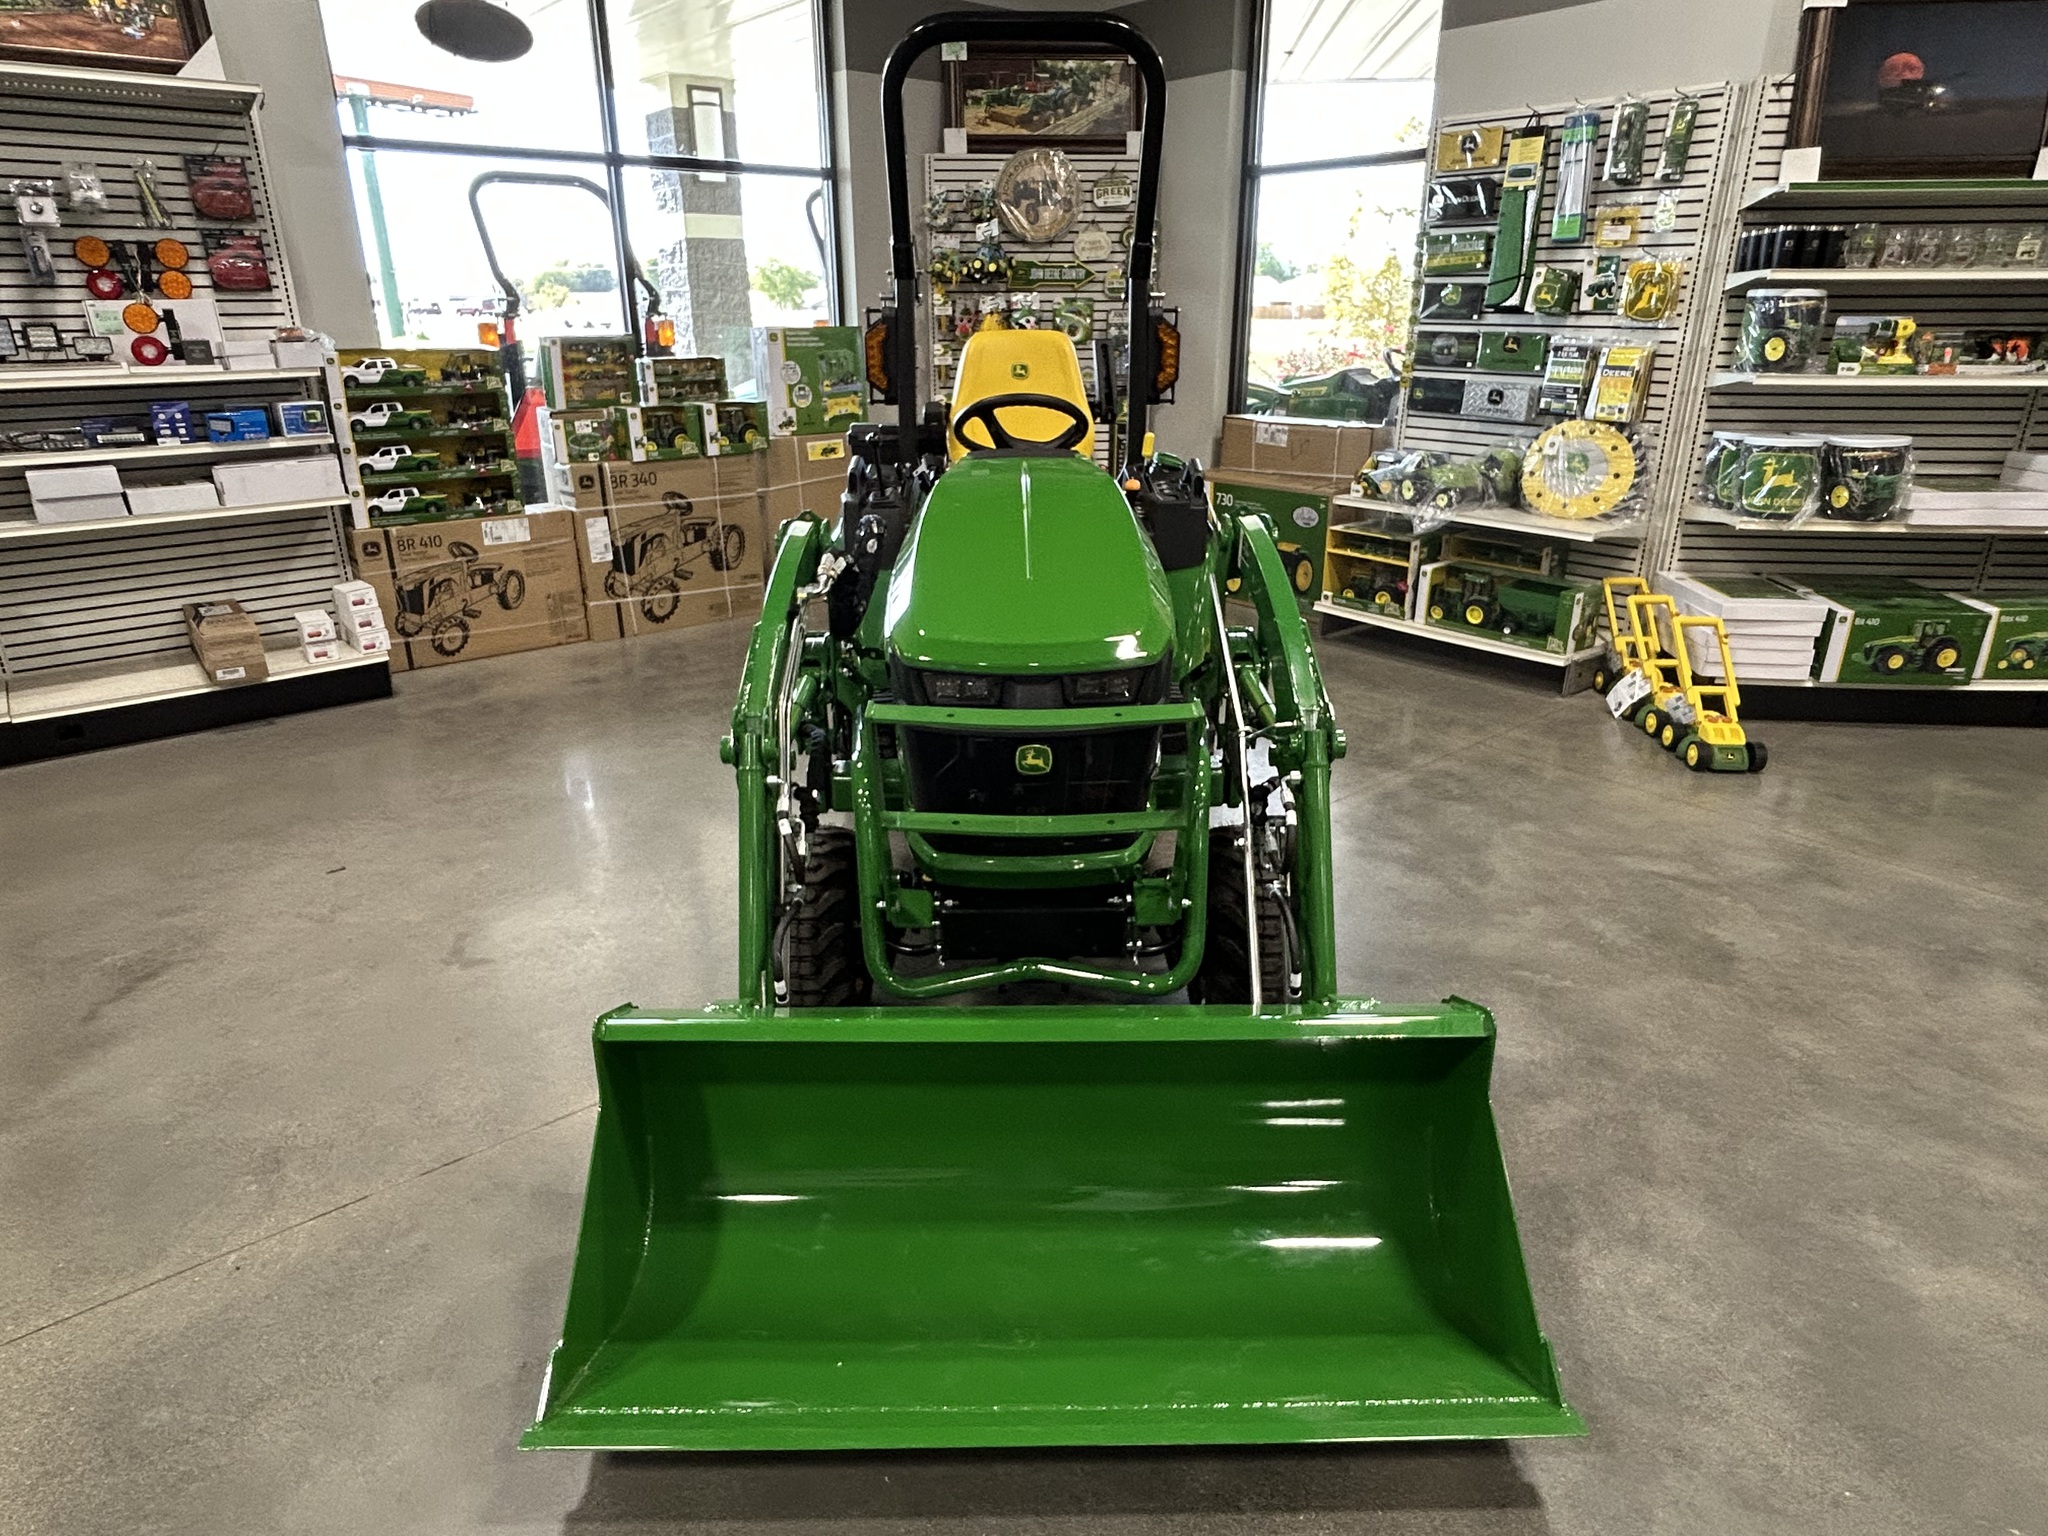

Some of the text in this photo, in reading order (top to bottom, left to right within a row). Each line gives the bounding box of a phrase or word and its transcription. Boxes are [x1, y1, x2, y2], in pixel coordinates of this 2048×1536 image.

[1096, 187, 1130, 199] GREEN
[1453, 240, 1485, 252] DEERE
[1030, 268, 1086, 279] JOHN DEERE COUNTRY
[1602, 368, 1633, 377] DEERE
[632, 471, 658, 487] 340
[1216, 492, 1234, 507] 730
[419, 534, 443, 549] 410
[1866, 617, 1881, 626] 410
[2015, 614, 2030, 623] 410
